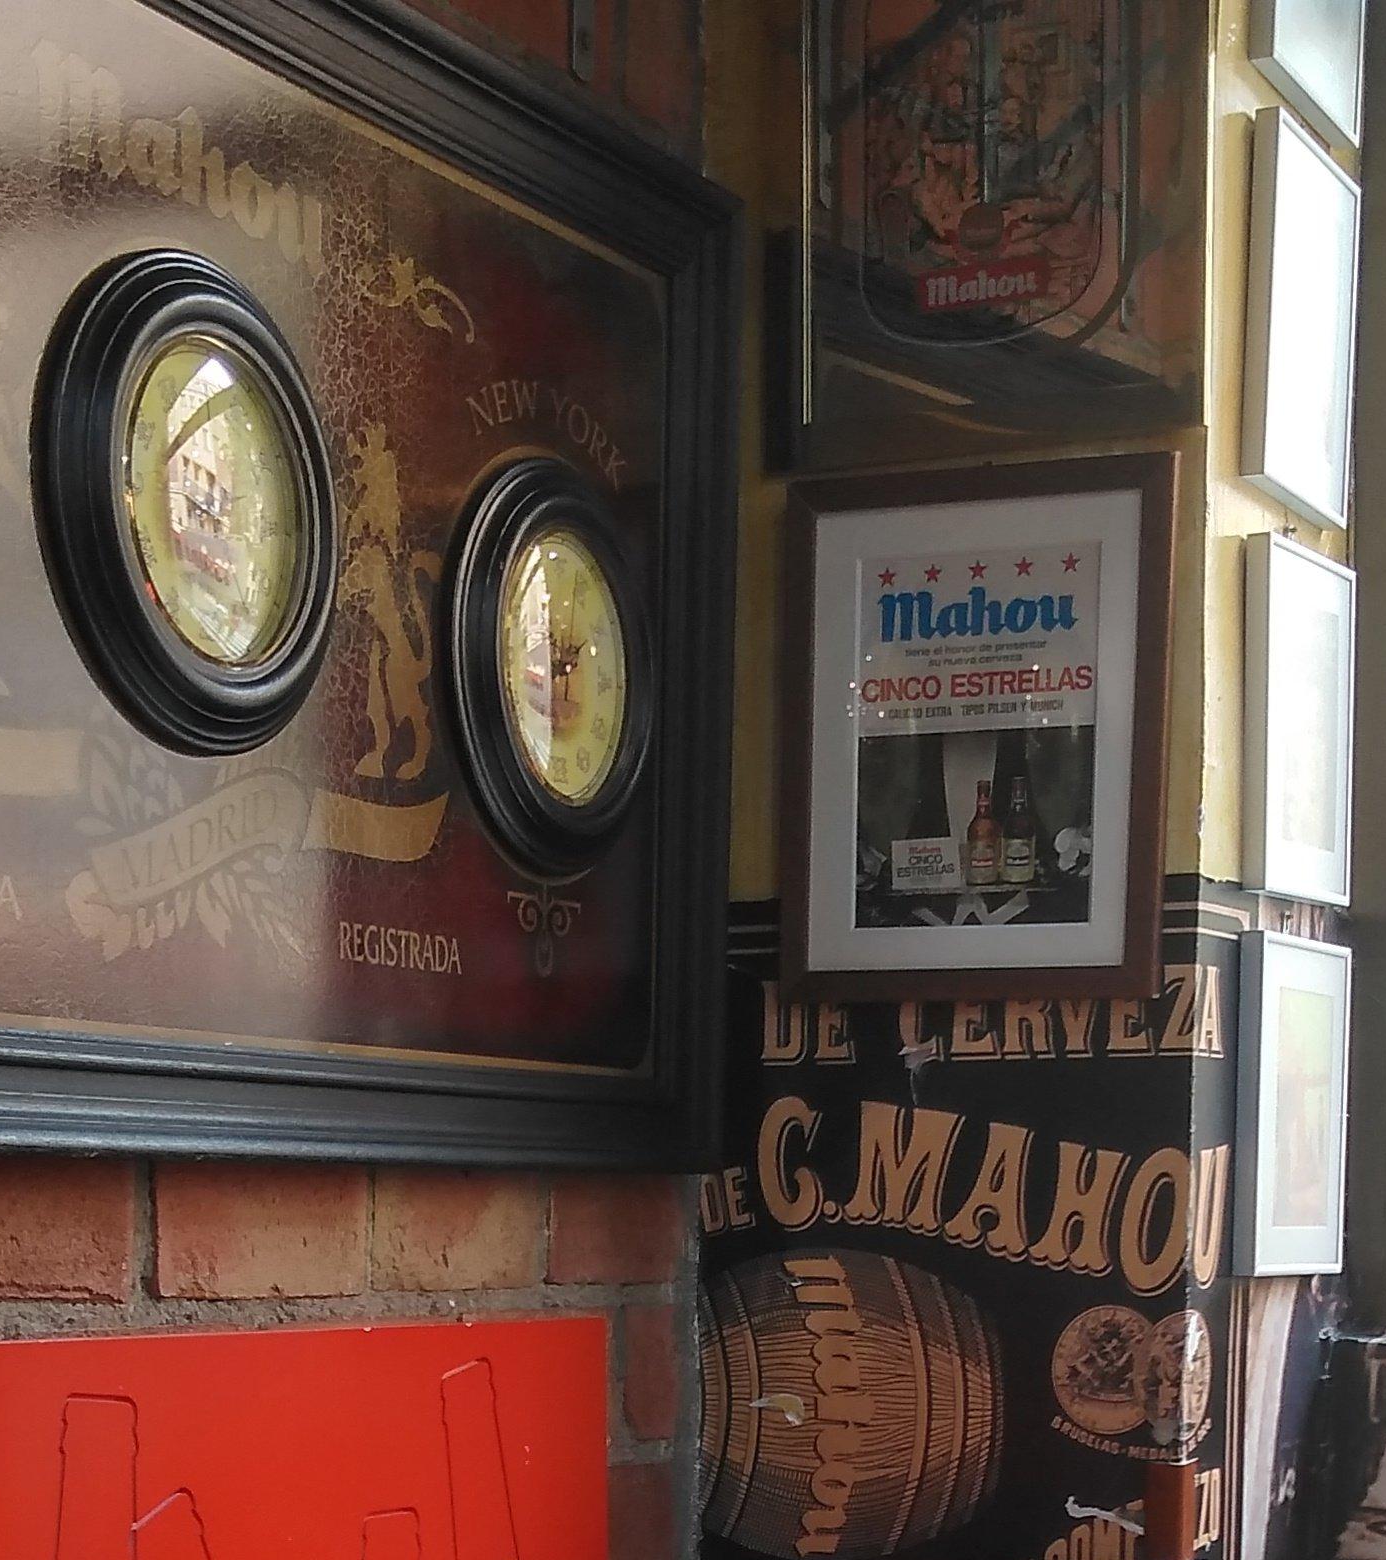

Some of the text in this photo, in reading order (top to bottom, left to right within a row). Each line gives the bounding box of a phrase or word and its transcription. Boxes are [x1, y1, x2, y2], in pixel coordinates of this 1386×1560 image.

[31, 40, 323, 276] Mahou
[926, 269, 1037, 306] Mahou
[465, 379, 630, 490] NEW YORK
[877, 586, 1079, 642] Mahou
[945, 644, 976, 654] honor
[979, 643, 993, 652] de
[861, 665, 1093, 702] CINCO ESTRELLAS
[121, 789, 279, 888] MADRID
[338, 920, 463, 976] REGISTRADA
[759, 964, 1226, 1067] DE CERVEZA
[699, 1096, 1231, 1296] DE C.MAHOU
[784, 1255, 878, 1557] Mahou
